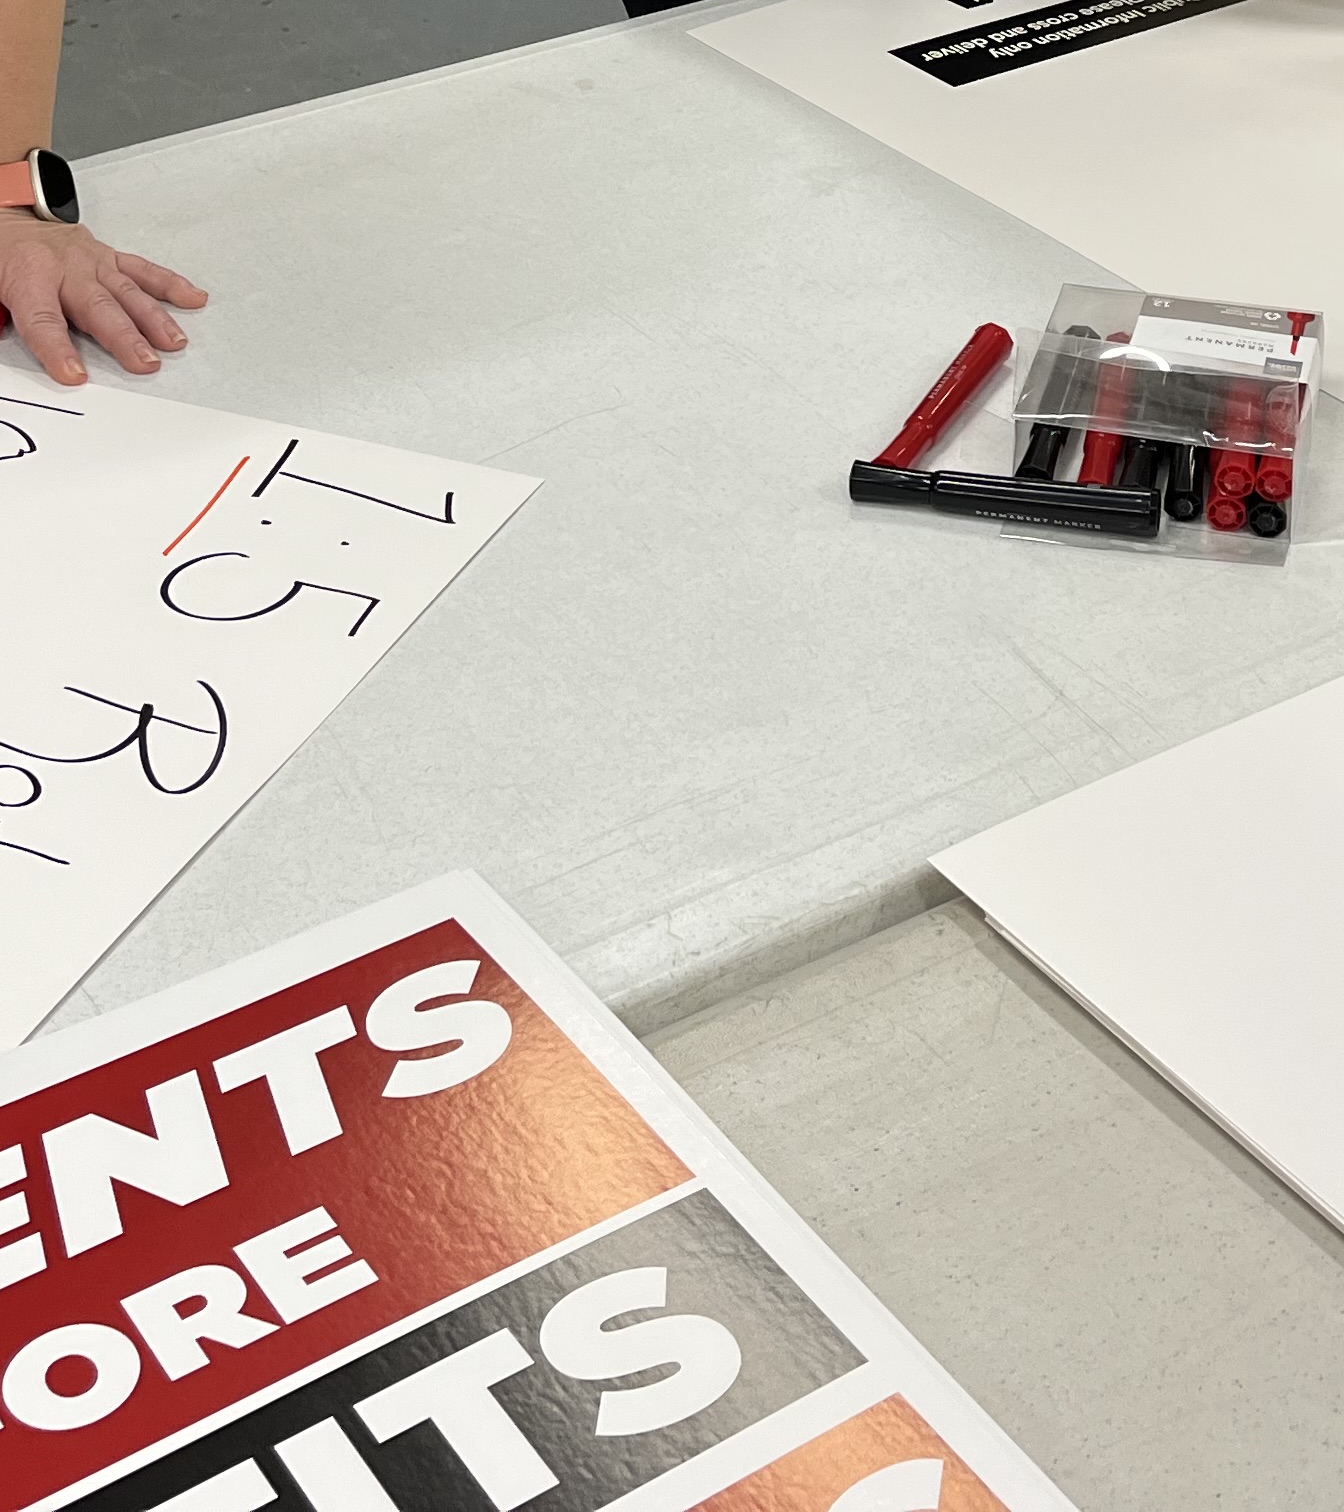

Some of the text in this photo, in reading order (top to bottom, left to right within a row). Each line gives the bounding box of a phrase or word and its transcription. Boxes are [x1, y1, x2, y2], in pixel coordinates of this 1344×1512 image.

[988, 26, 1028, 44] and
[1026, 12, 1079, 32] cross
[1031, 9, 1146, 45] Information
[921, 37, 993, 63] deliver
[988, 41, 1034, 59] only
[160, 438, 457, 638] 1:5
[143, 1266, 742, 1512] ITS
